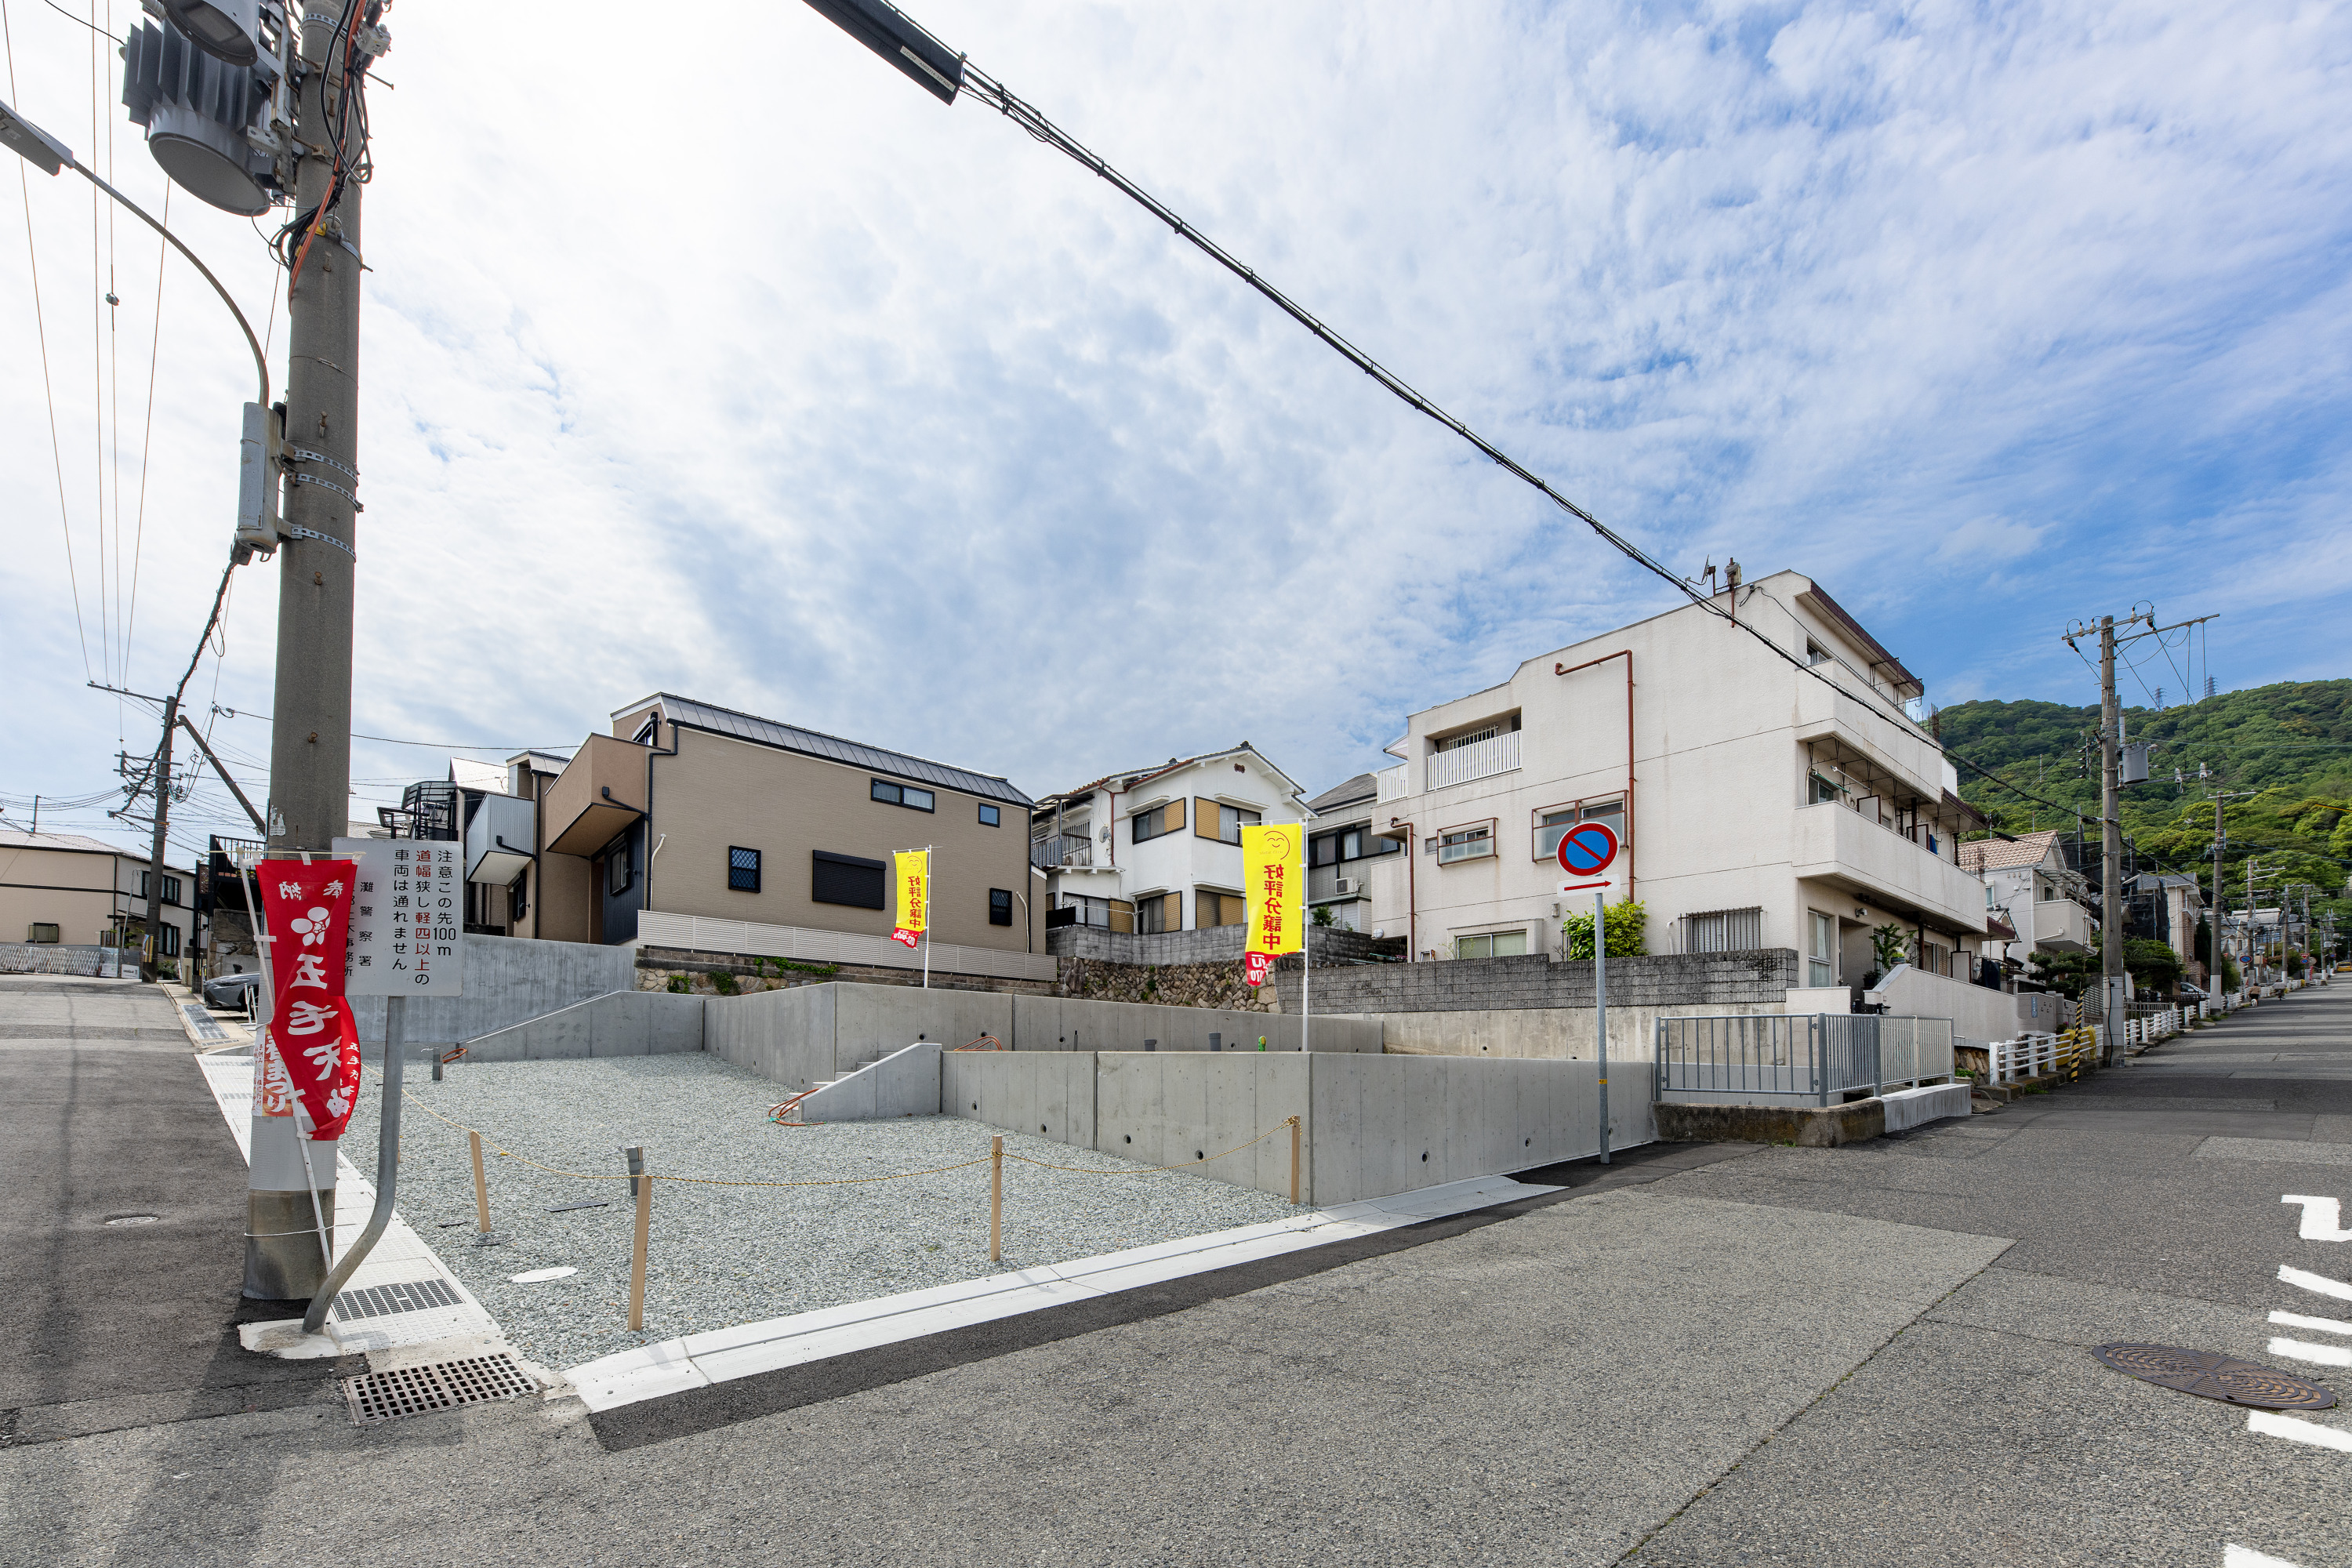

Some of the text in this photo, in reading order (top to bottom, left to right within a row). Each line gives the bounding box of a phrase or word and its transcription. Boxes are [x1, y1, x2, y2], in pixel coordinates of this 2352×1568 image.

[358, 881, 374, 967] 灘警察署
[392, 849, 409, 971] 車両は通れません
[415, 850, 431, 985] 道幅狭し軽四以上の
[434, 850, 456, 956] 注意この先100m
